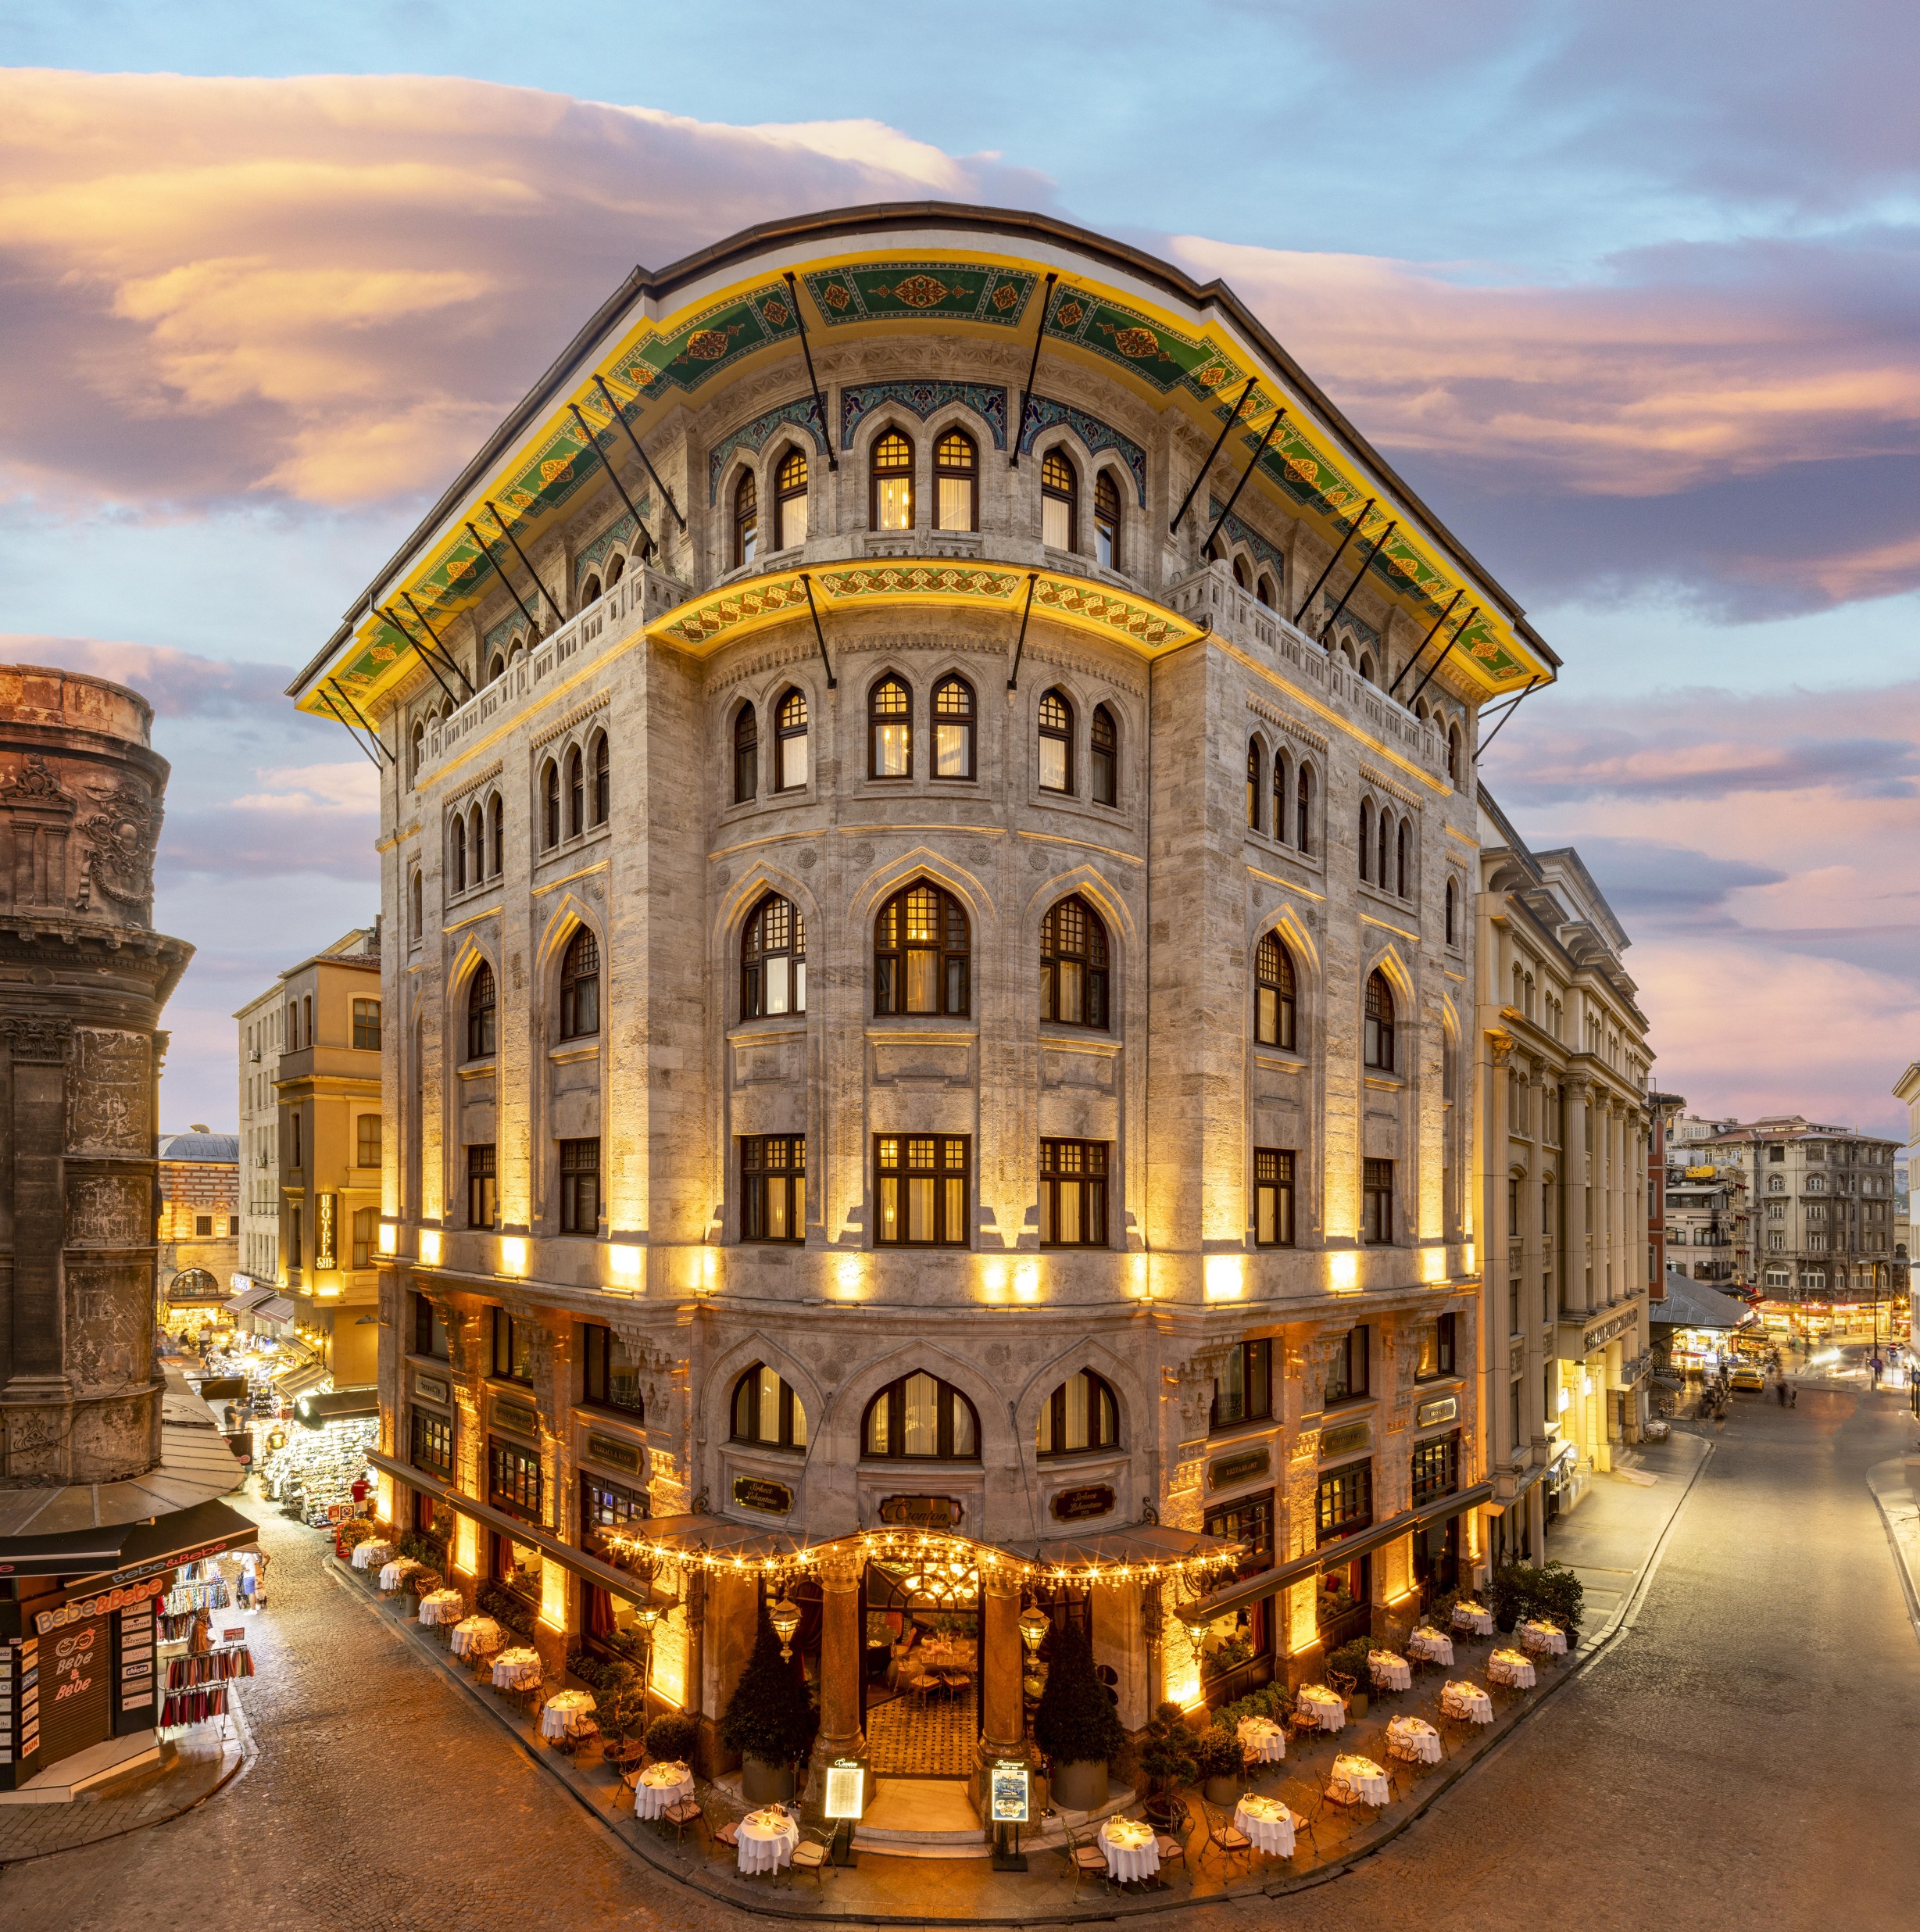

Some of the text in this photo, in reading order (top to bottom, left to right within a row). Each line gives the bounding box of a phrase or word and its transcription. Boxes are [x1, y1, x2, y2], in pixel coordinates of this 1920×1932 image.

[321, 1194, 332, 1257] HOTEL
[1226, 1462, 1257, 1476] RESTAURANT
[750, 1483, 773, 1494] Sirkeci
[112, 1542, 227, 1584] Bebe&Bebe
[36, 1578, 163, 1633] Bebe&Bebe
[56, 1652, 93, 1675] Bebe
[127, 1665, 148, 1675] chicco
[70, 1669, 80, 1680] &
[55, 1678, 91, 1701] Bebe
[23, 1737, 38, 1755] NUK
